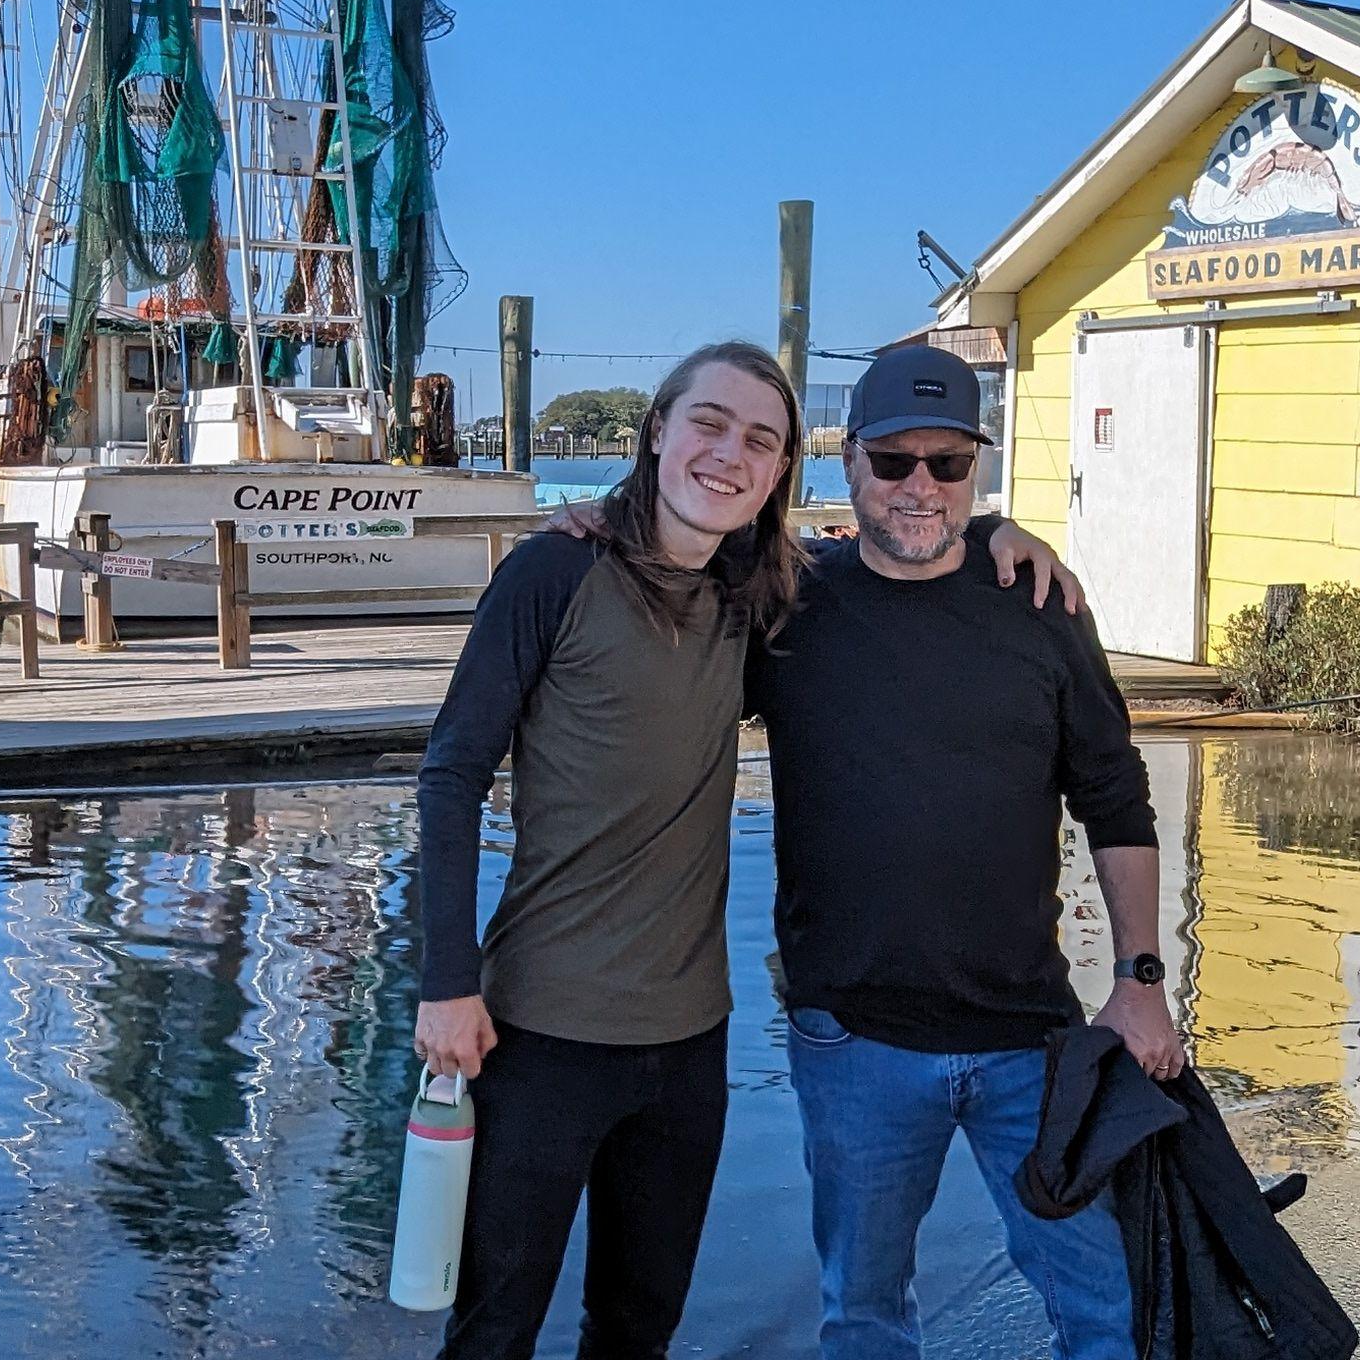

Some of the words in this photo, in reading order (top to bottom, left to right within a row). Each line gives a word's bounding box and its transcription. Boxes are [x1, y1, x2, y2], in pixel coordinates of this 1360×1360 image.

[1185, 223, 1266, 246] WHOLESALE
[1154, 251, 1282, 287] SEAFOOD
[234, 485, 320, 511] CAPE
[327, 488, 422, 512] POINT
[244, 522, 357, 539] POTTER'S
[104, 555, 136, 565] EMPLOYEES
[137, 558, 151, 566] ONLY
[104, 566, 113, 574] DO
[114, 566, 128, 575] NOT
[129, 568, 149, 576] ENTER
